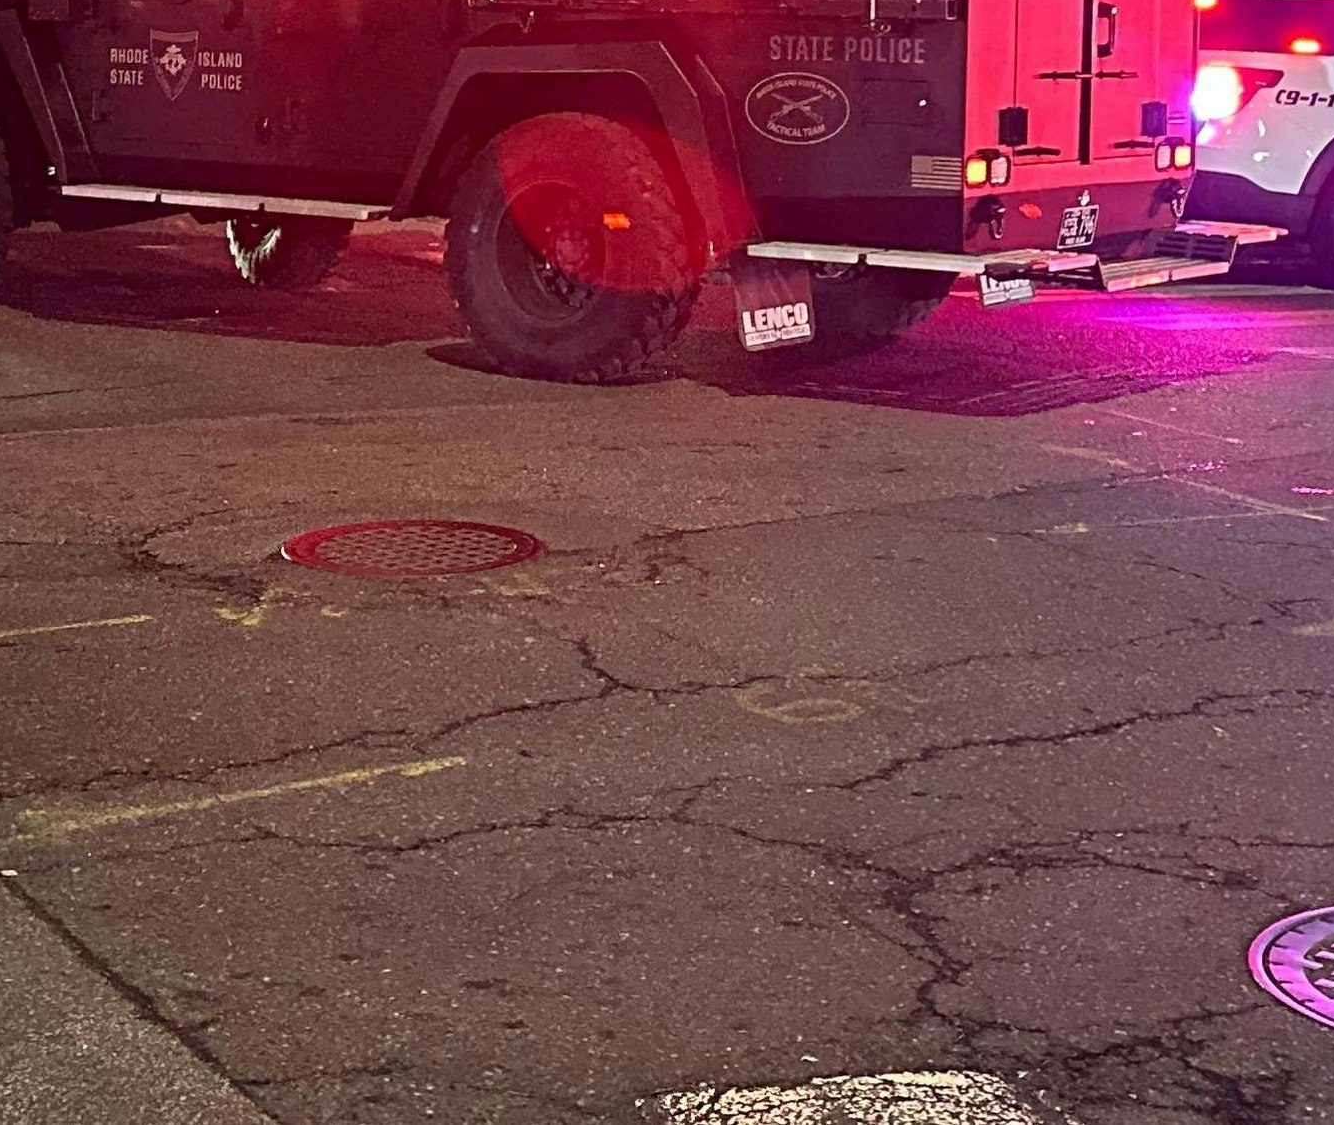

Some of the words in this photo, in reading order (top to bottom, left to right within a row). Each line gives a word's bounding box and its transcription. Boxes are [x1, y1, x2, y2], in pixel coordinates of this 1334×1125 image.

[110, 48, 149, 64] RHODE
[198, 52, 243, 68] ISLAND
[770, 34, 834, 62] STATE
[844, 36, 926, 64] POLICE
[110, 69, 144, 85] STATE
[201, 74, 243, 90] POLICE
[767, 121, 803, 137] TACTICAL
[742, 302, 808, 333] LENCO
